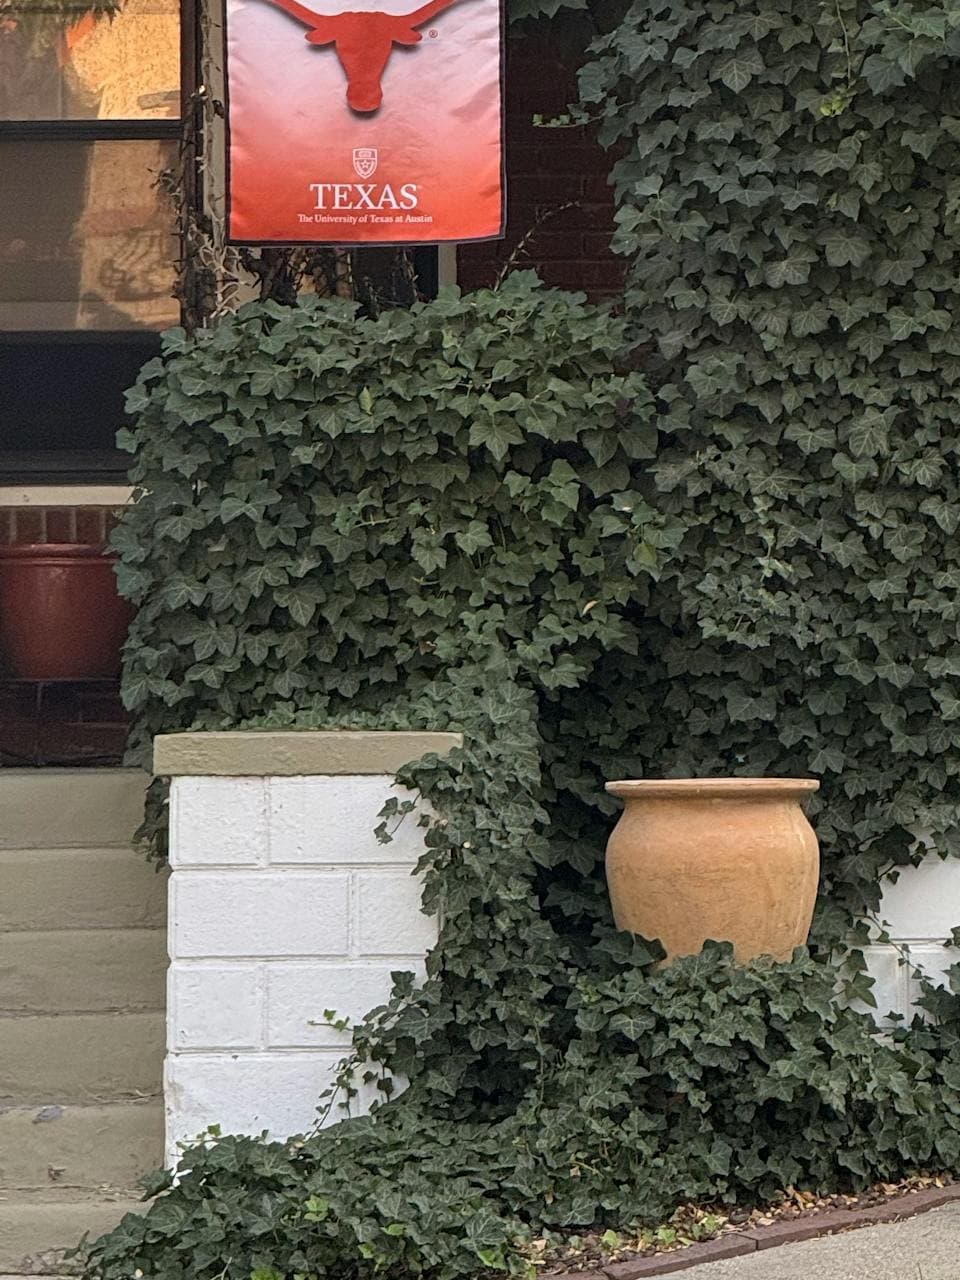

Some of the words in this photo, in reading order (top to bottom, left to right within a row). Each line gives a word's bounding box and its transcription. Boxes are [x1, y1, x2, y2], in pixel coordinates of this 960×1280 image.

[310, 183, 418, 210] TEXAS
[297, 213, 313, 223] The
[314, 213, 357, 225] University
[358, 213, 369, 223] of
[369, 214, 393, 223] Texas
[394, 214, 403, 223] at
[405, 214, 433, 223] Austin
